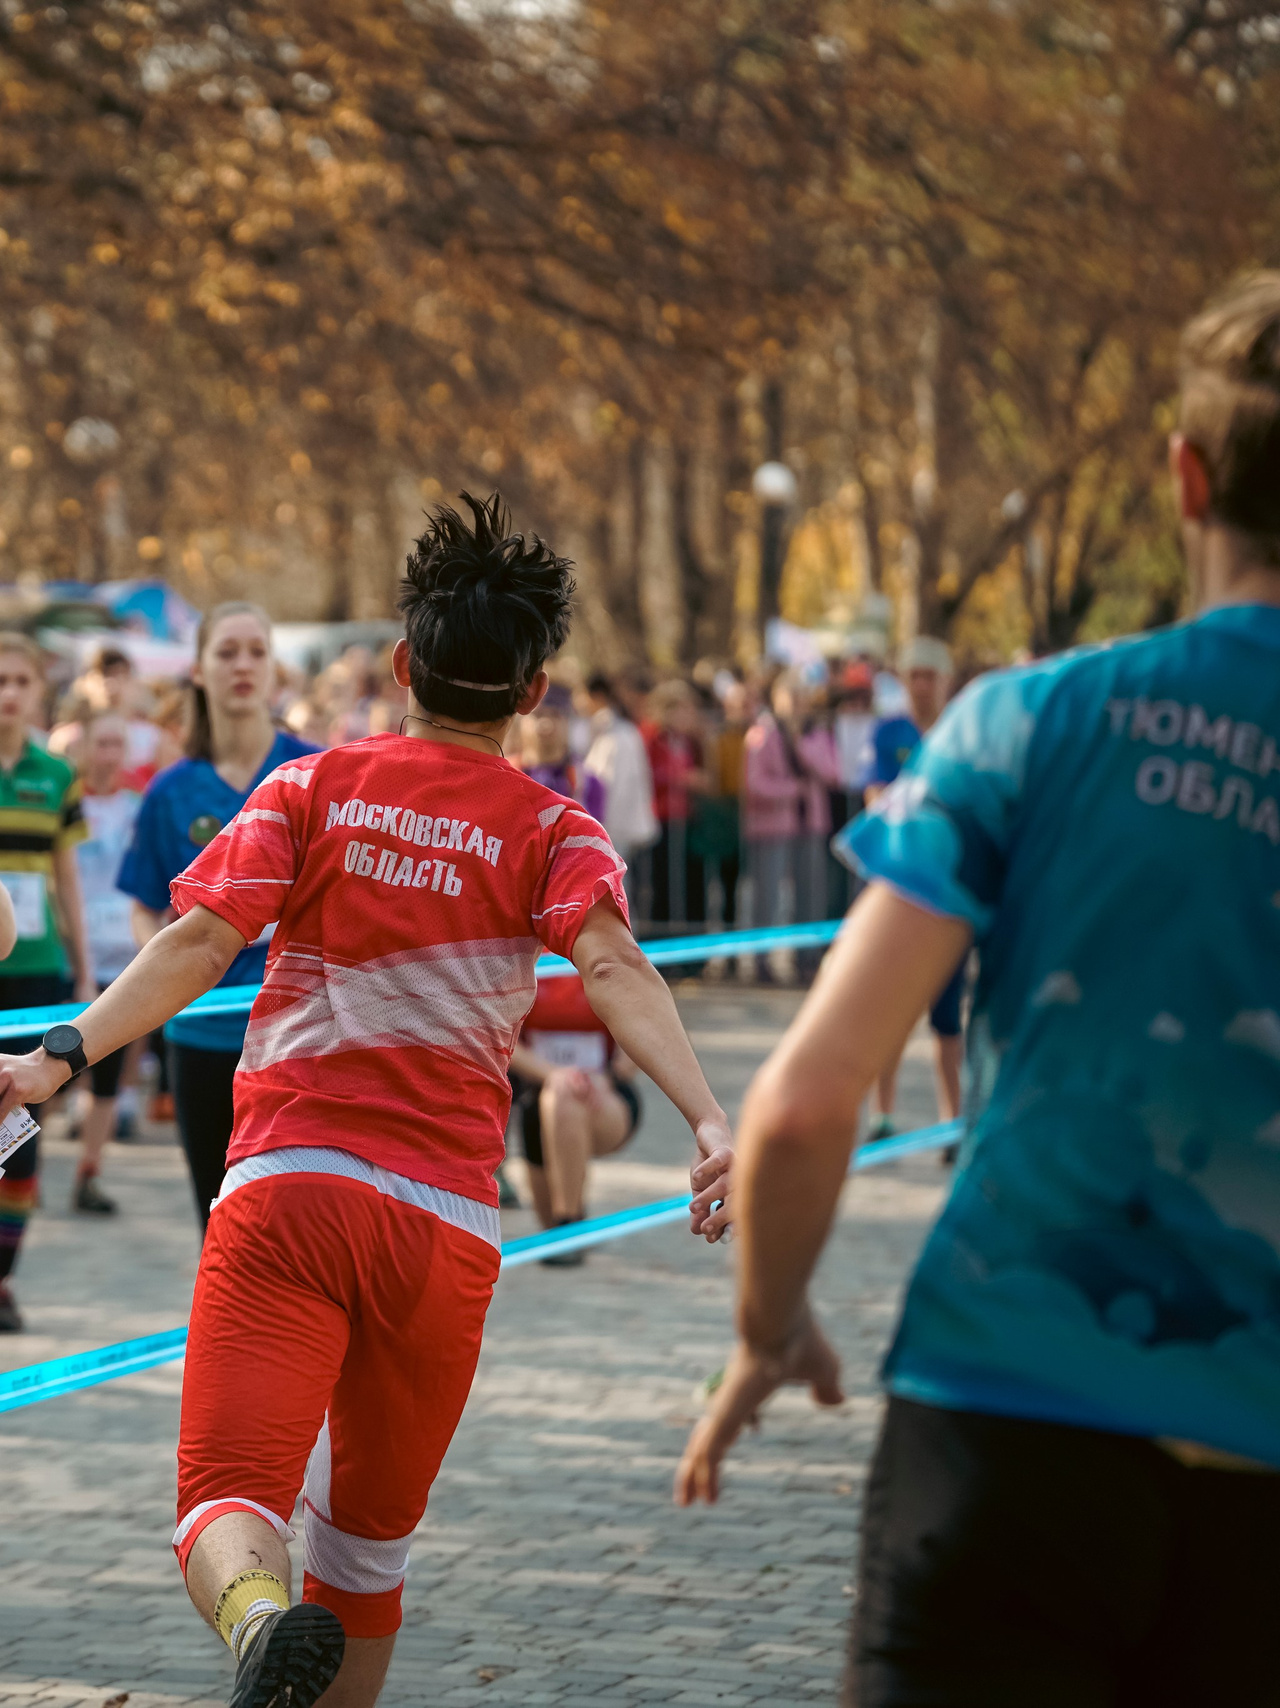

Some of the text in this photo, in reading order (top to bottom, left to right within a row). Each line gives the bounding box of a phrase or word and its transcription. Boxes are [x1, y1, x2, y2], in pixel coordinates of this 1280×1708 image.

[325, 798, 503, 868] МОСКОВСКАЯ
[1135, 755, 1280, 847] ОБЛА
[344, 840, 463, 897] ОБЛАСТЬ
